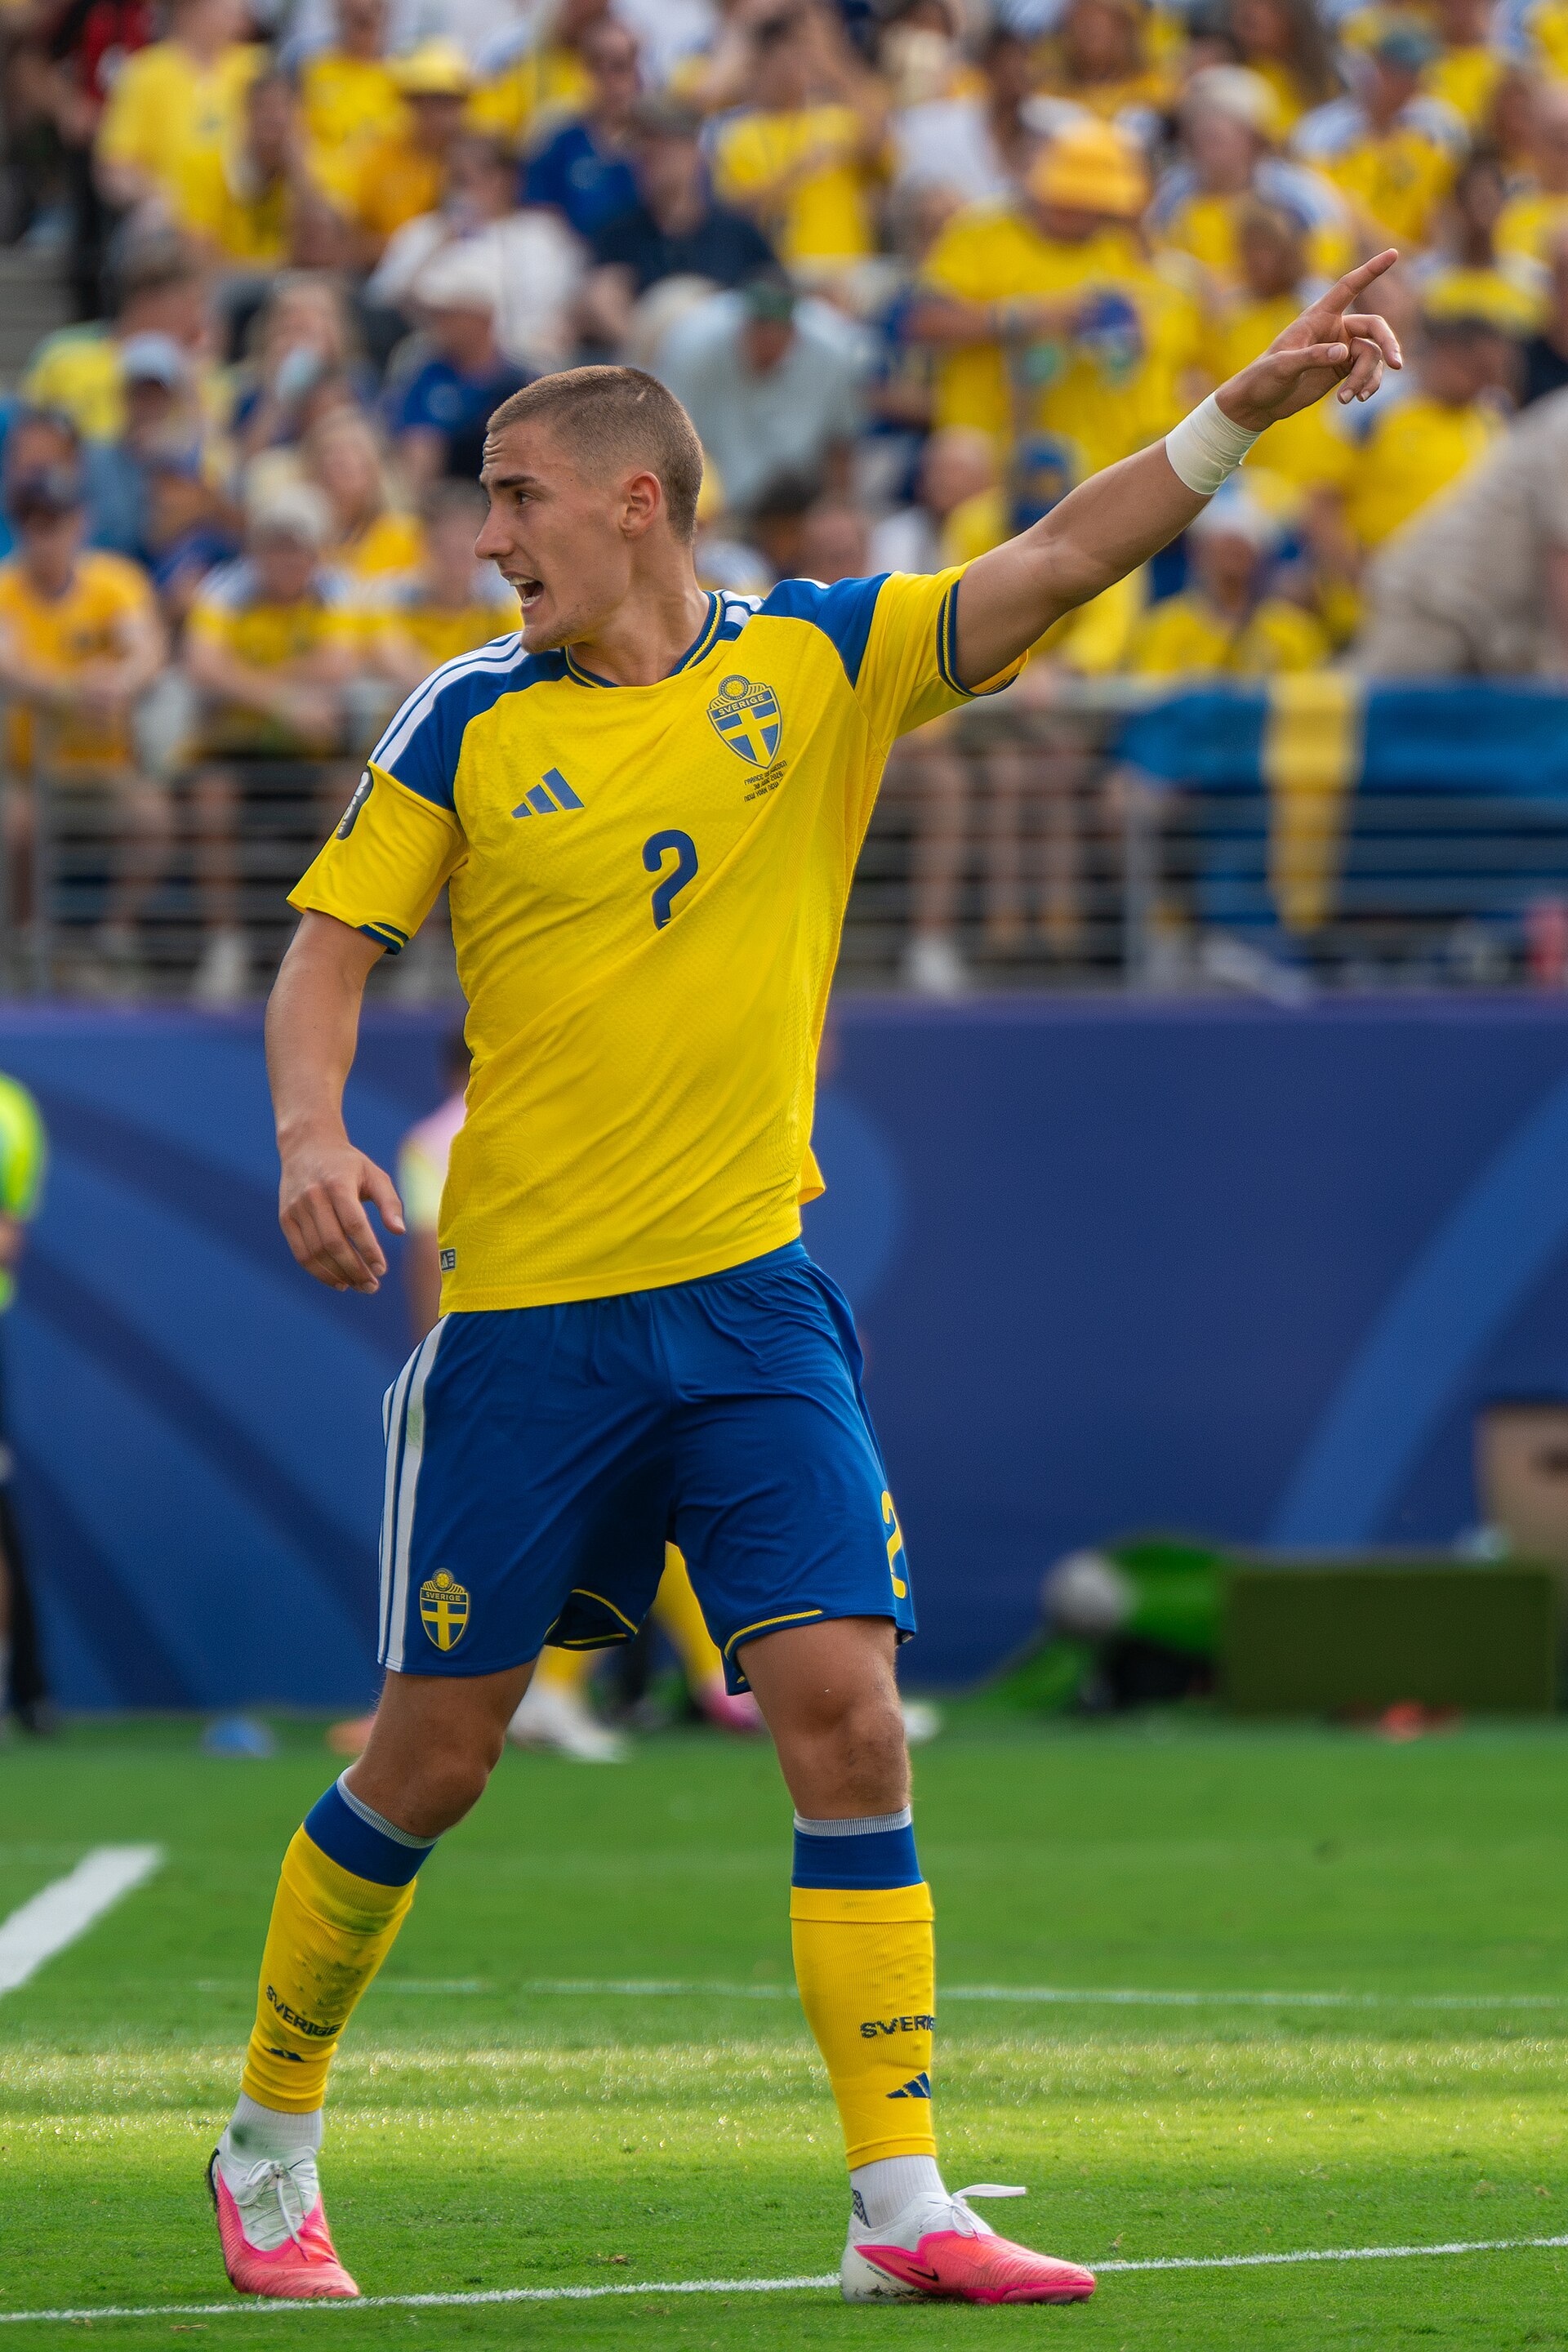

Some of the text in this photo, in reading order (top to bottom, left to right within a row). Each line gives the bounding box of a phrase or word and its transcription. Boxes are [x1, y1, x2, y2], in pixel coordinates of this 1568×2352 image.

[718, 694, 765, 716] SVERIGE
[642, 829, 699, 931] 2
[425, 1591, 461, 1602] SVERIGE
[266, 1984, 343, 2036] SVERIGE
